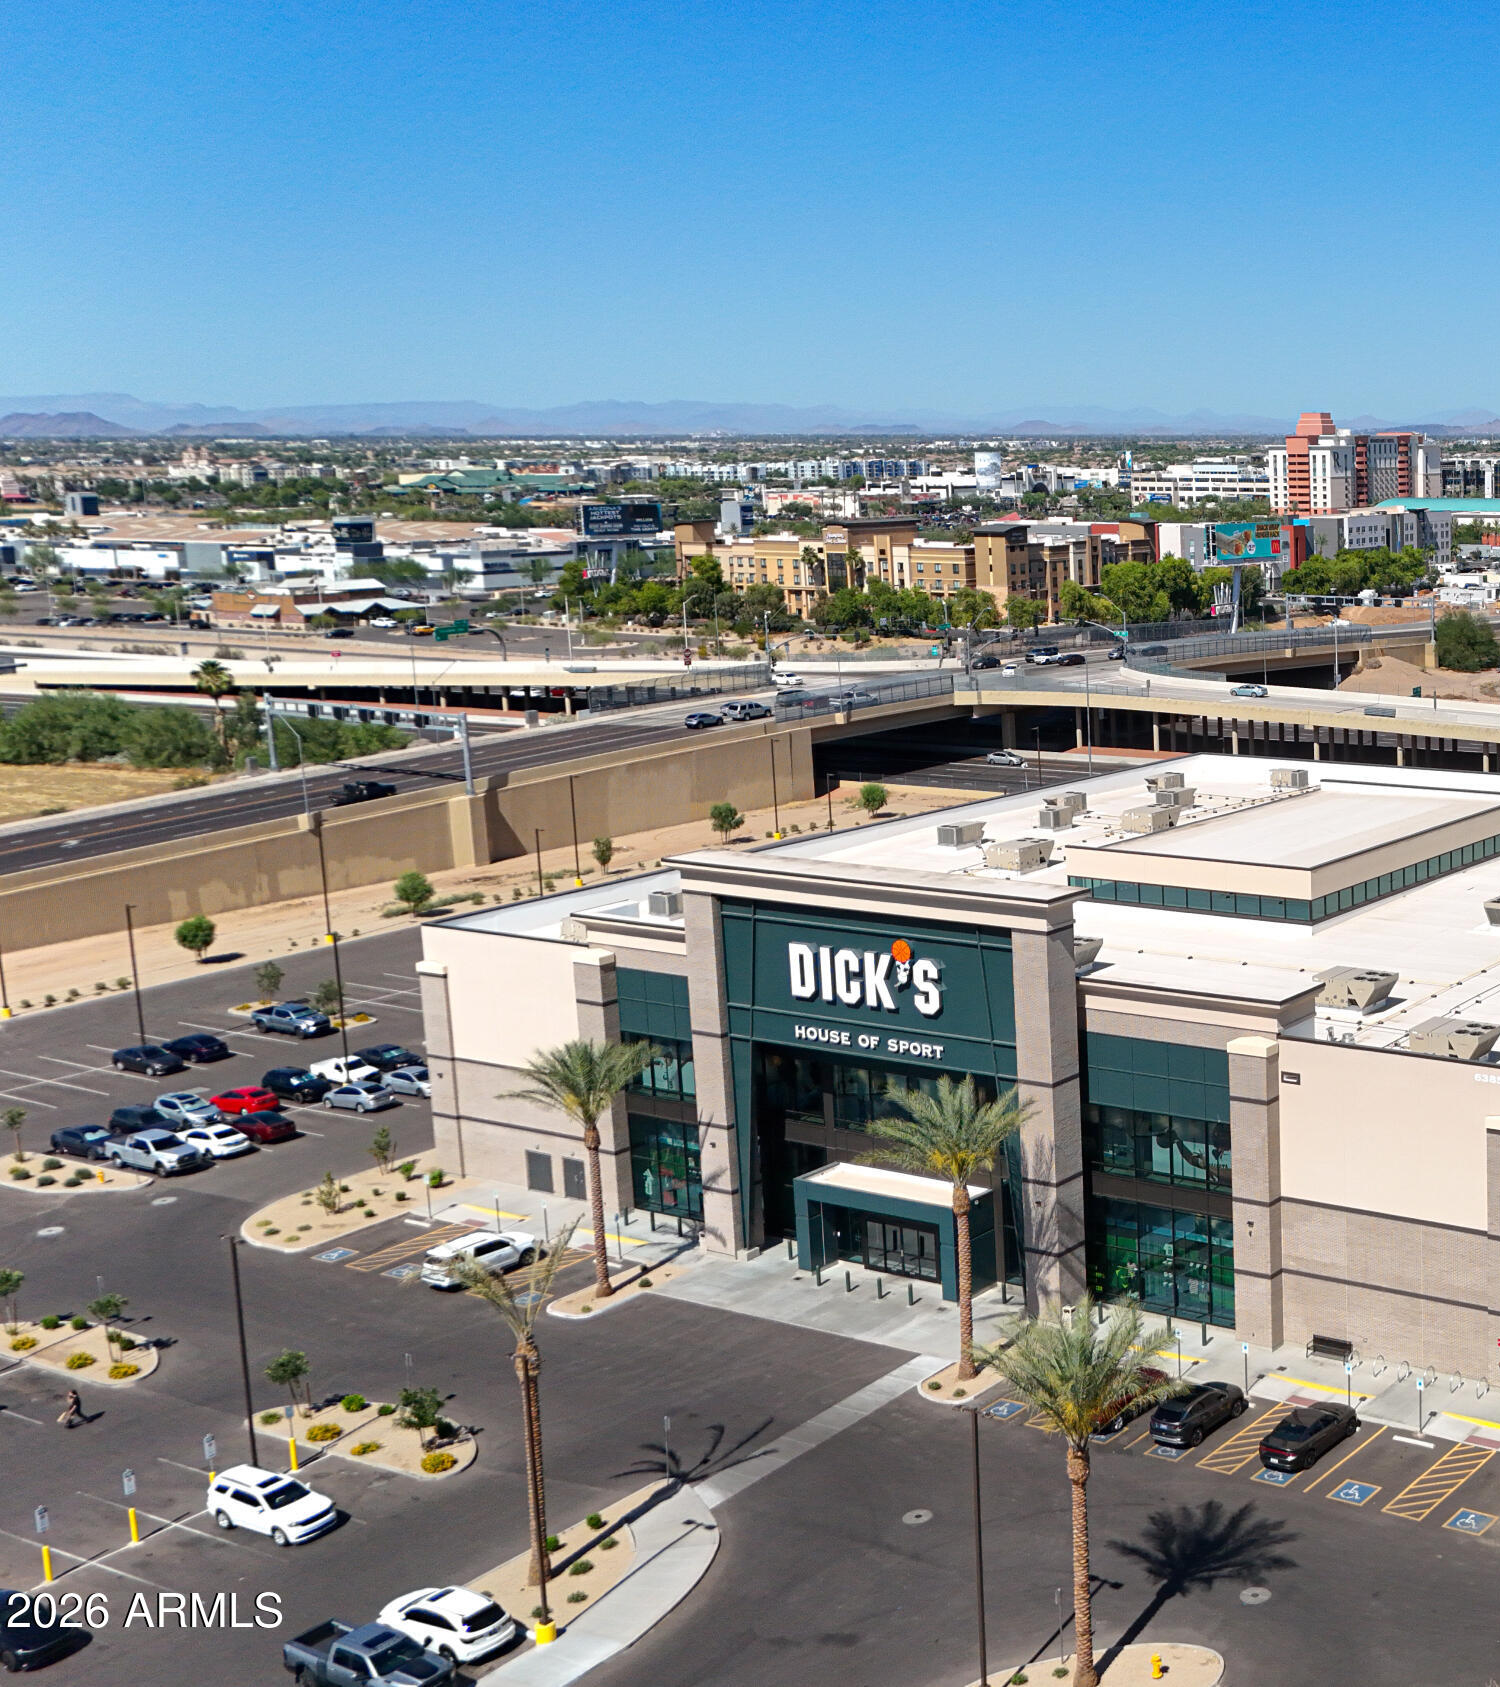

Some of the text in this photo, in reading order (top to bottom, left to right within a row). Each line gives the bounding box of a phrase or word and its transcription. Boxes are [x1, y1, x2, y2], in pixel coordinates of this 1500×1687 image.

[788, 939, 943, 1016] DICK'S
[794, 1024, 944, 1060] HOUSE OF SPORT
